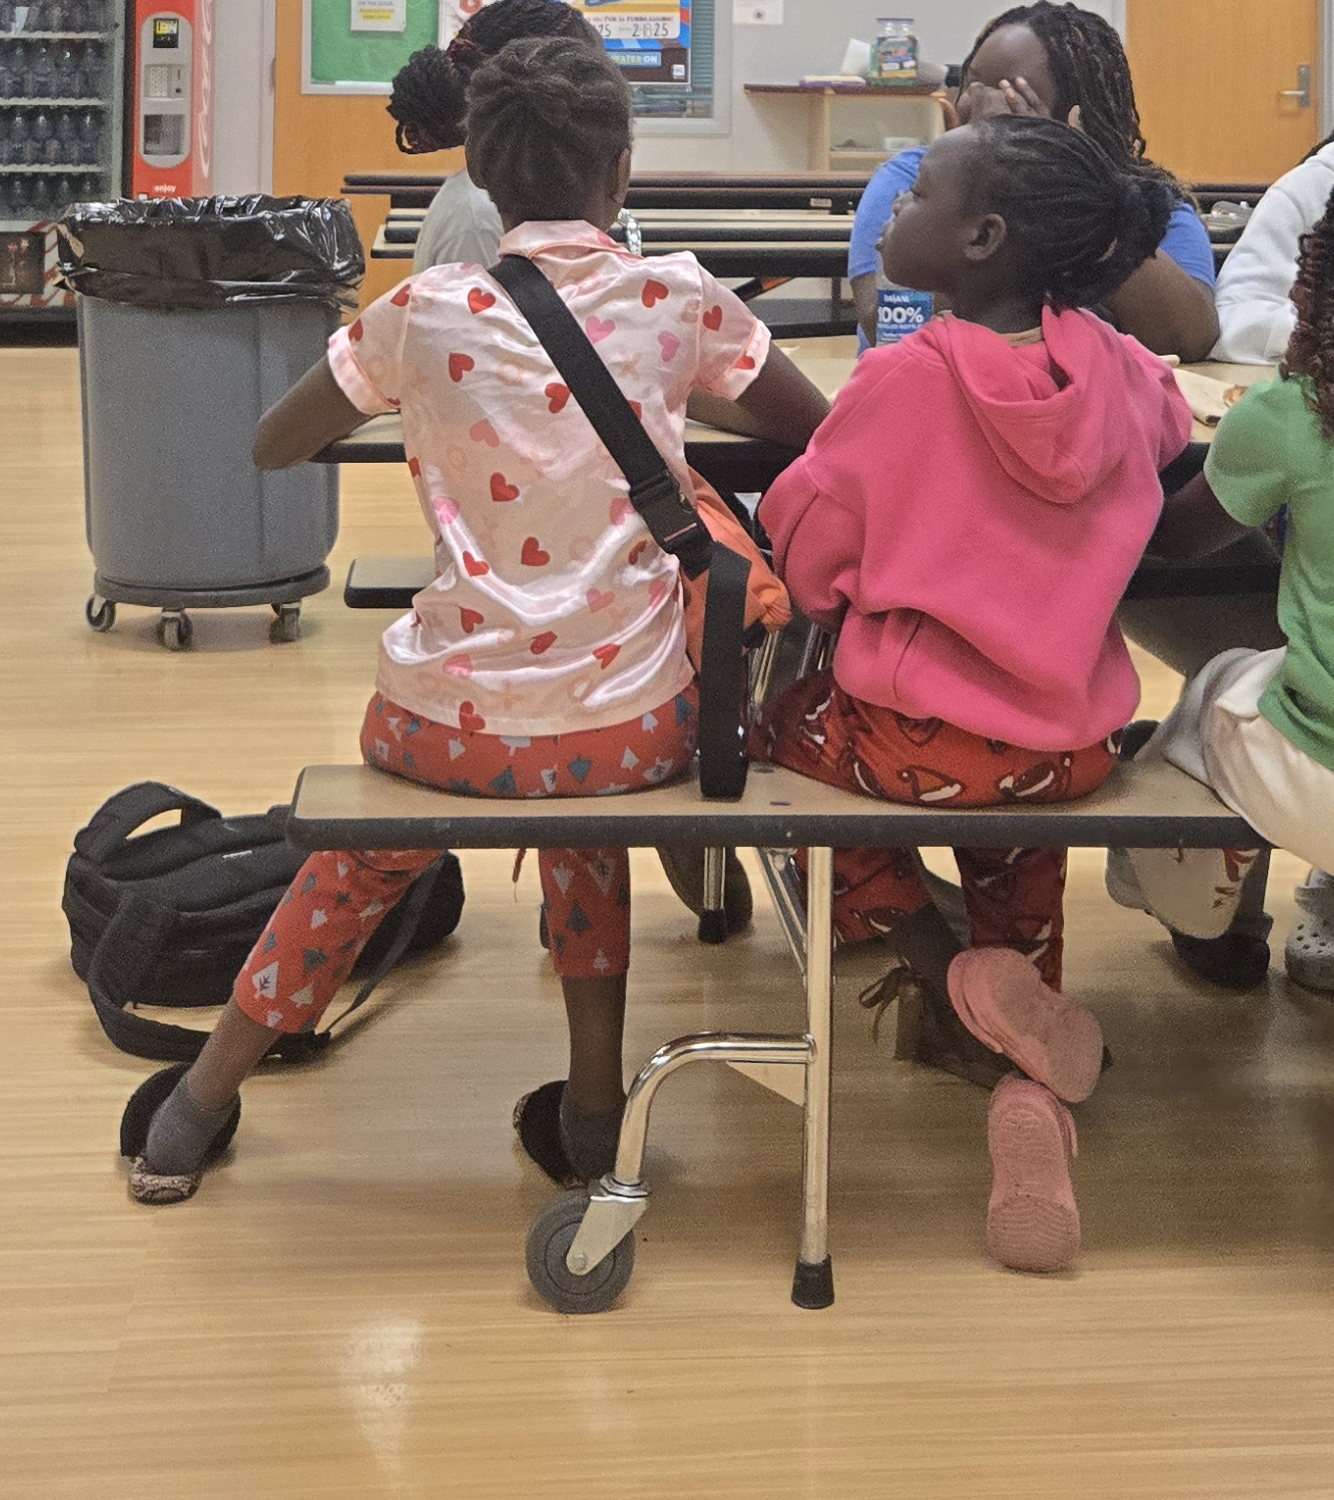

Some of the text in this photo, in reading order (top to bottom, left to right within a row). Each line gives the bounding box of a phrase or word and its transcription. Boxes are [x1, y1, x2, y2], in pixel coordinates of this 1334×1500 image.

[643, 55, 659, 64] ON
[154, 183, 177, 194] enjoy
[878, 306, 924, 323] 100%
